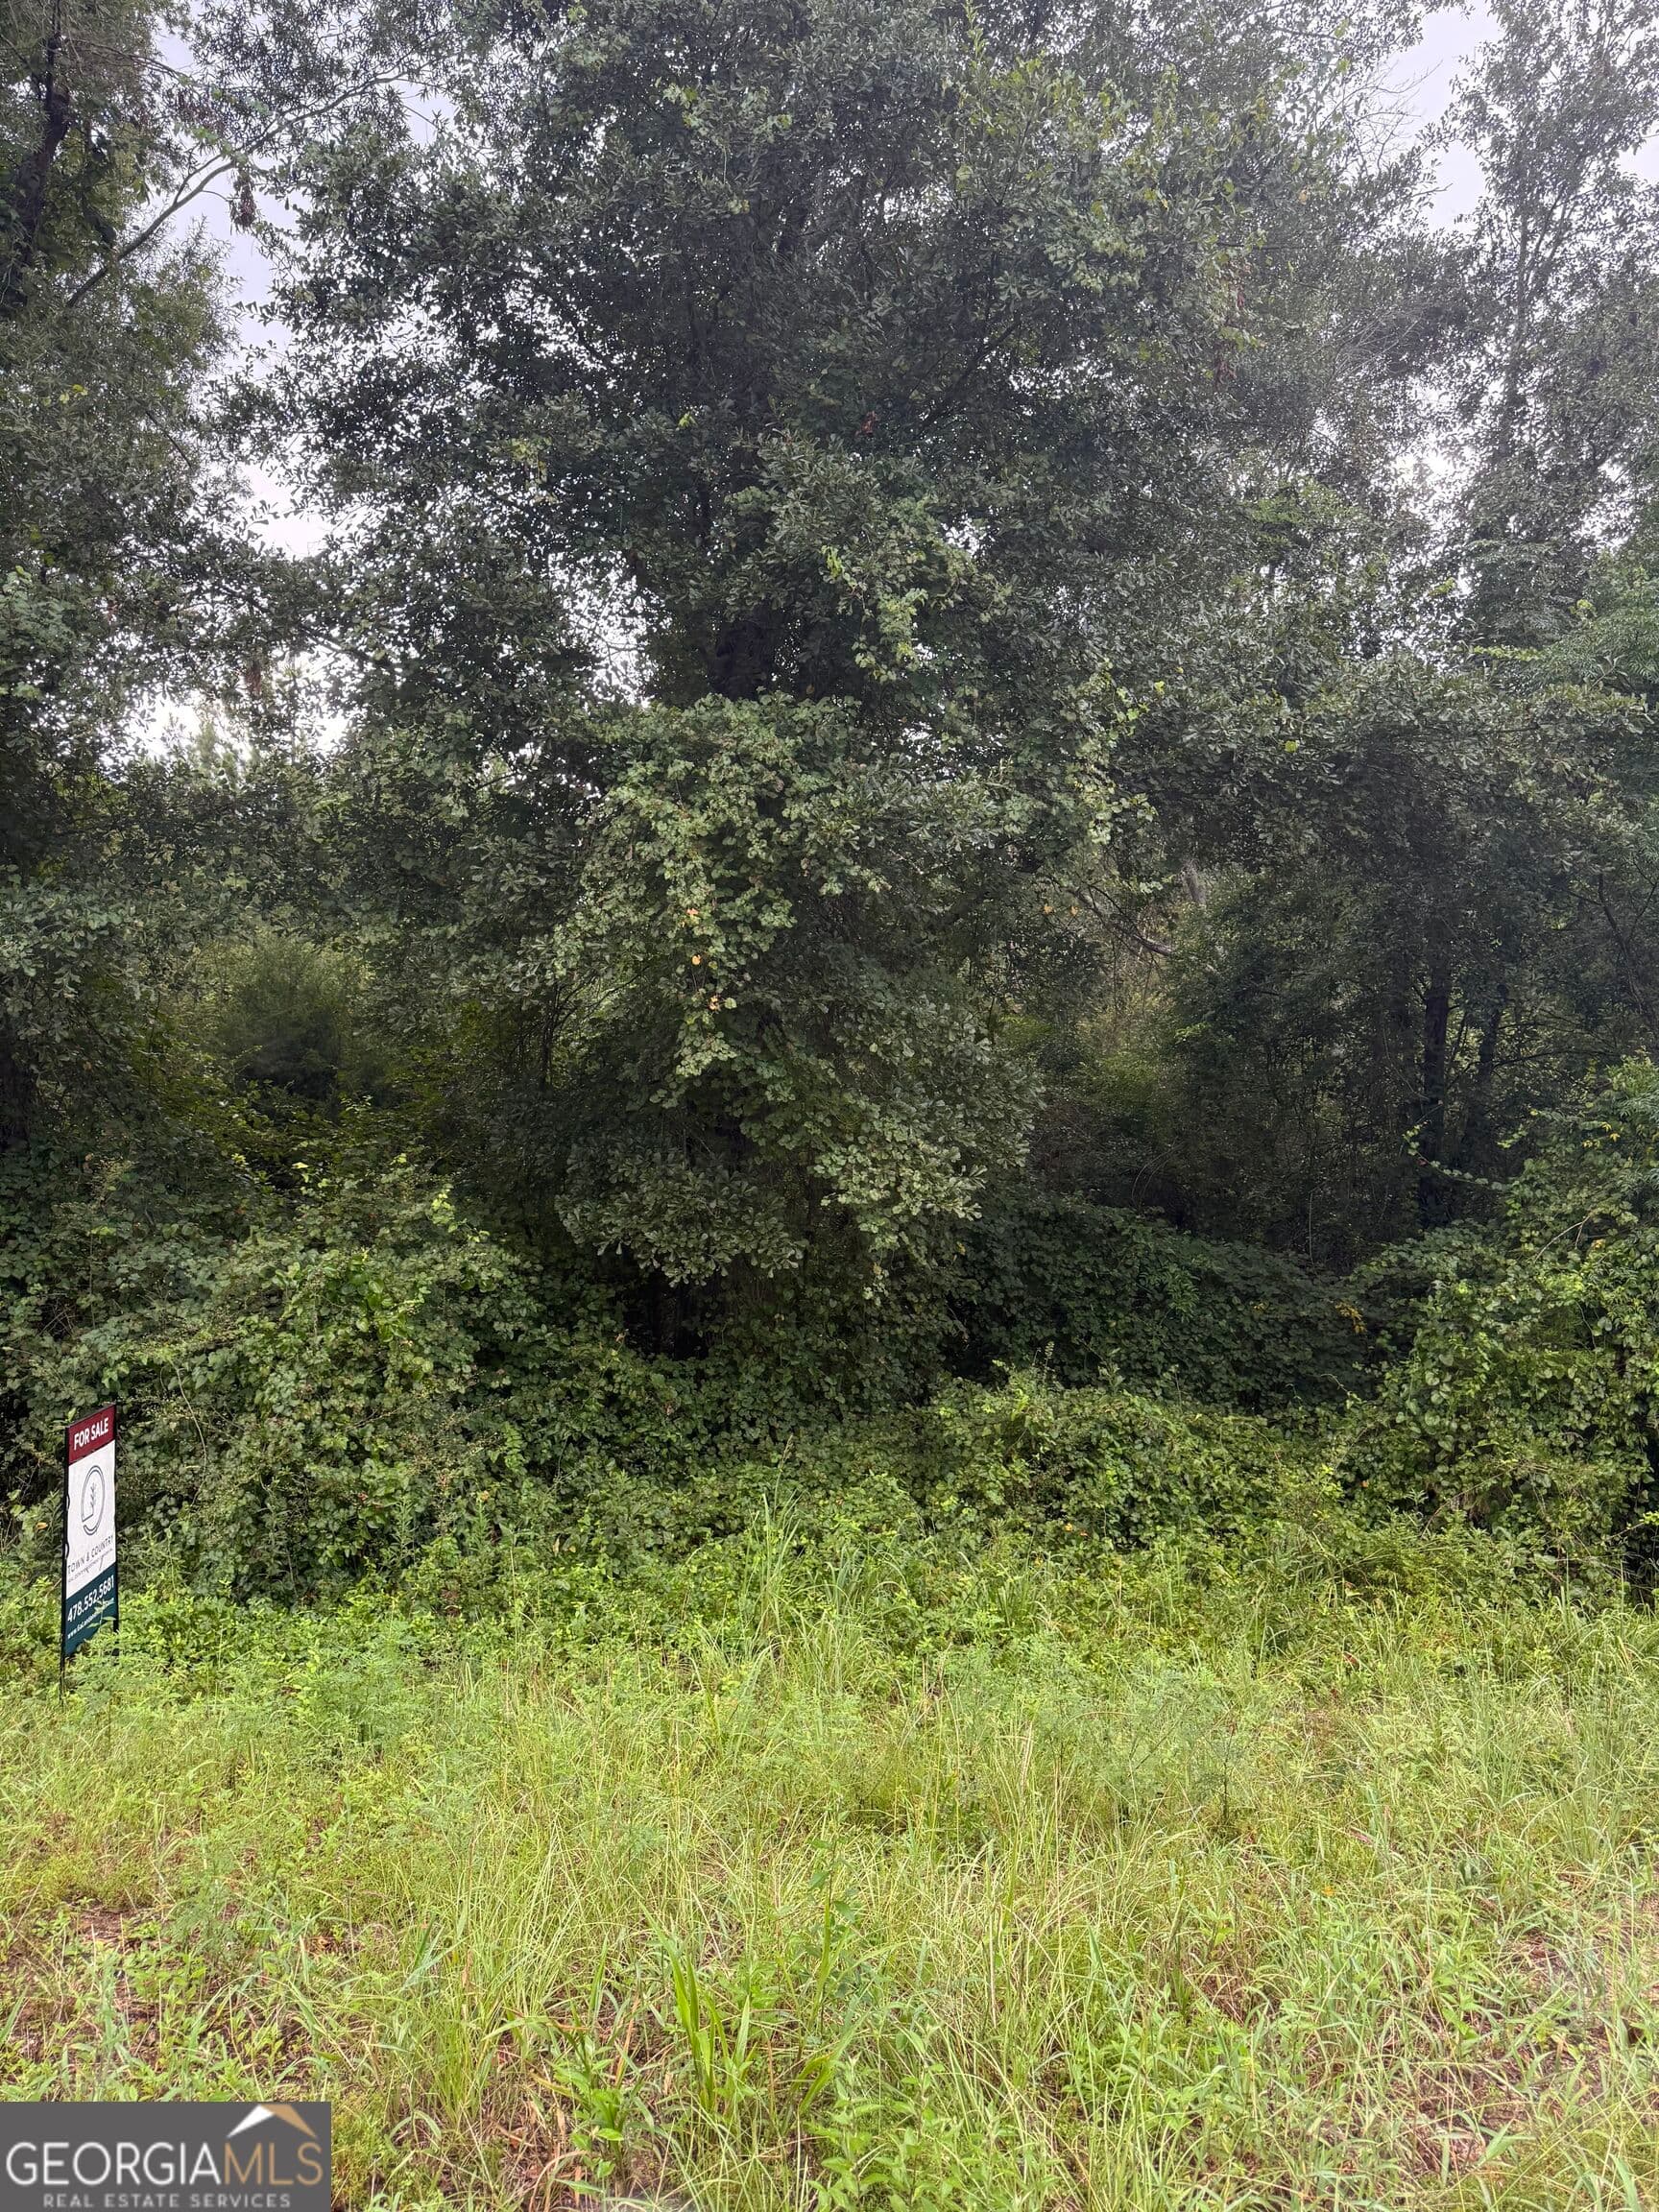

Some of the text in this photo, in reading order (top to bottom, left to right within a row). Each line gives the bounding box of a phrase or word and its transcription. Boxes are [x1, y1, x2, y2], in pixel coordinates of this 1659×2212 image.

[74, 1417, 108, 1451] FOR SALE
[67, 1555, 84, 1575] TOWN
[67, 1574, 114, 1623] 478.552.5681
